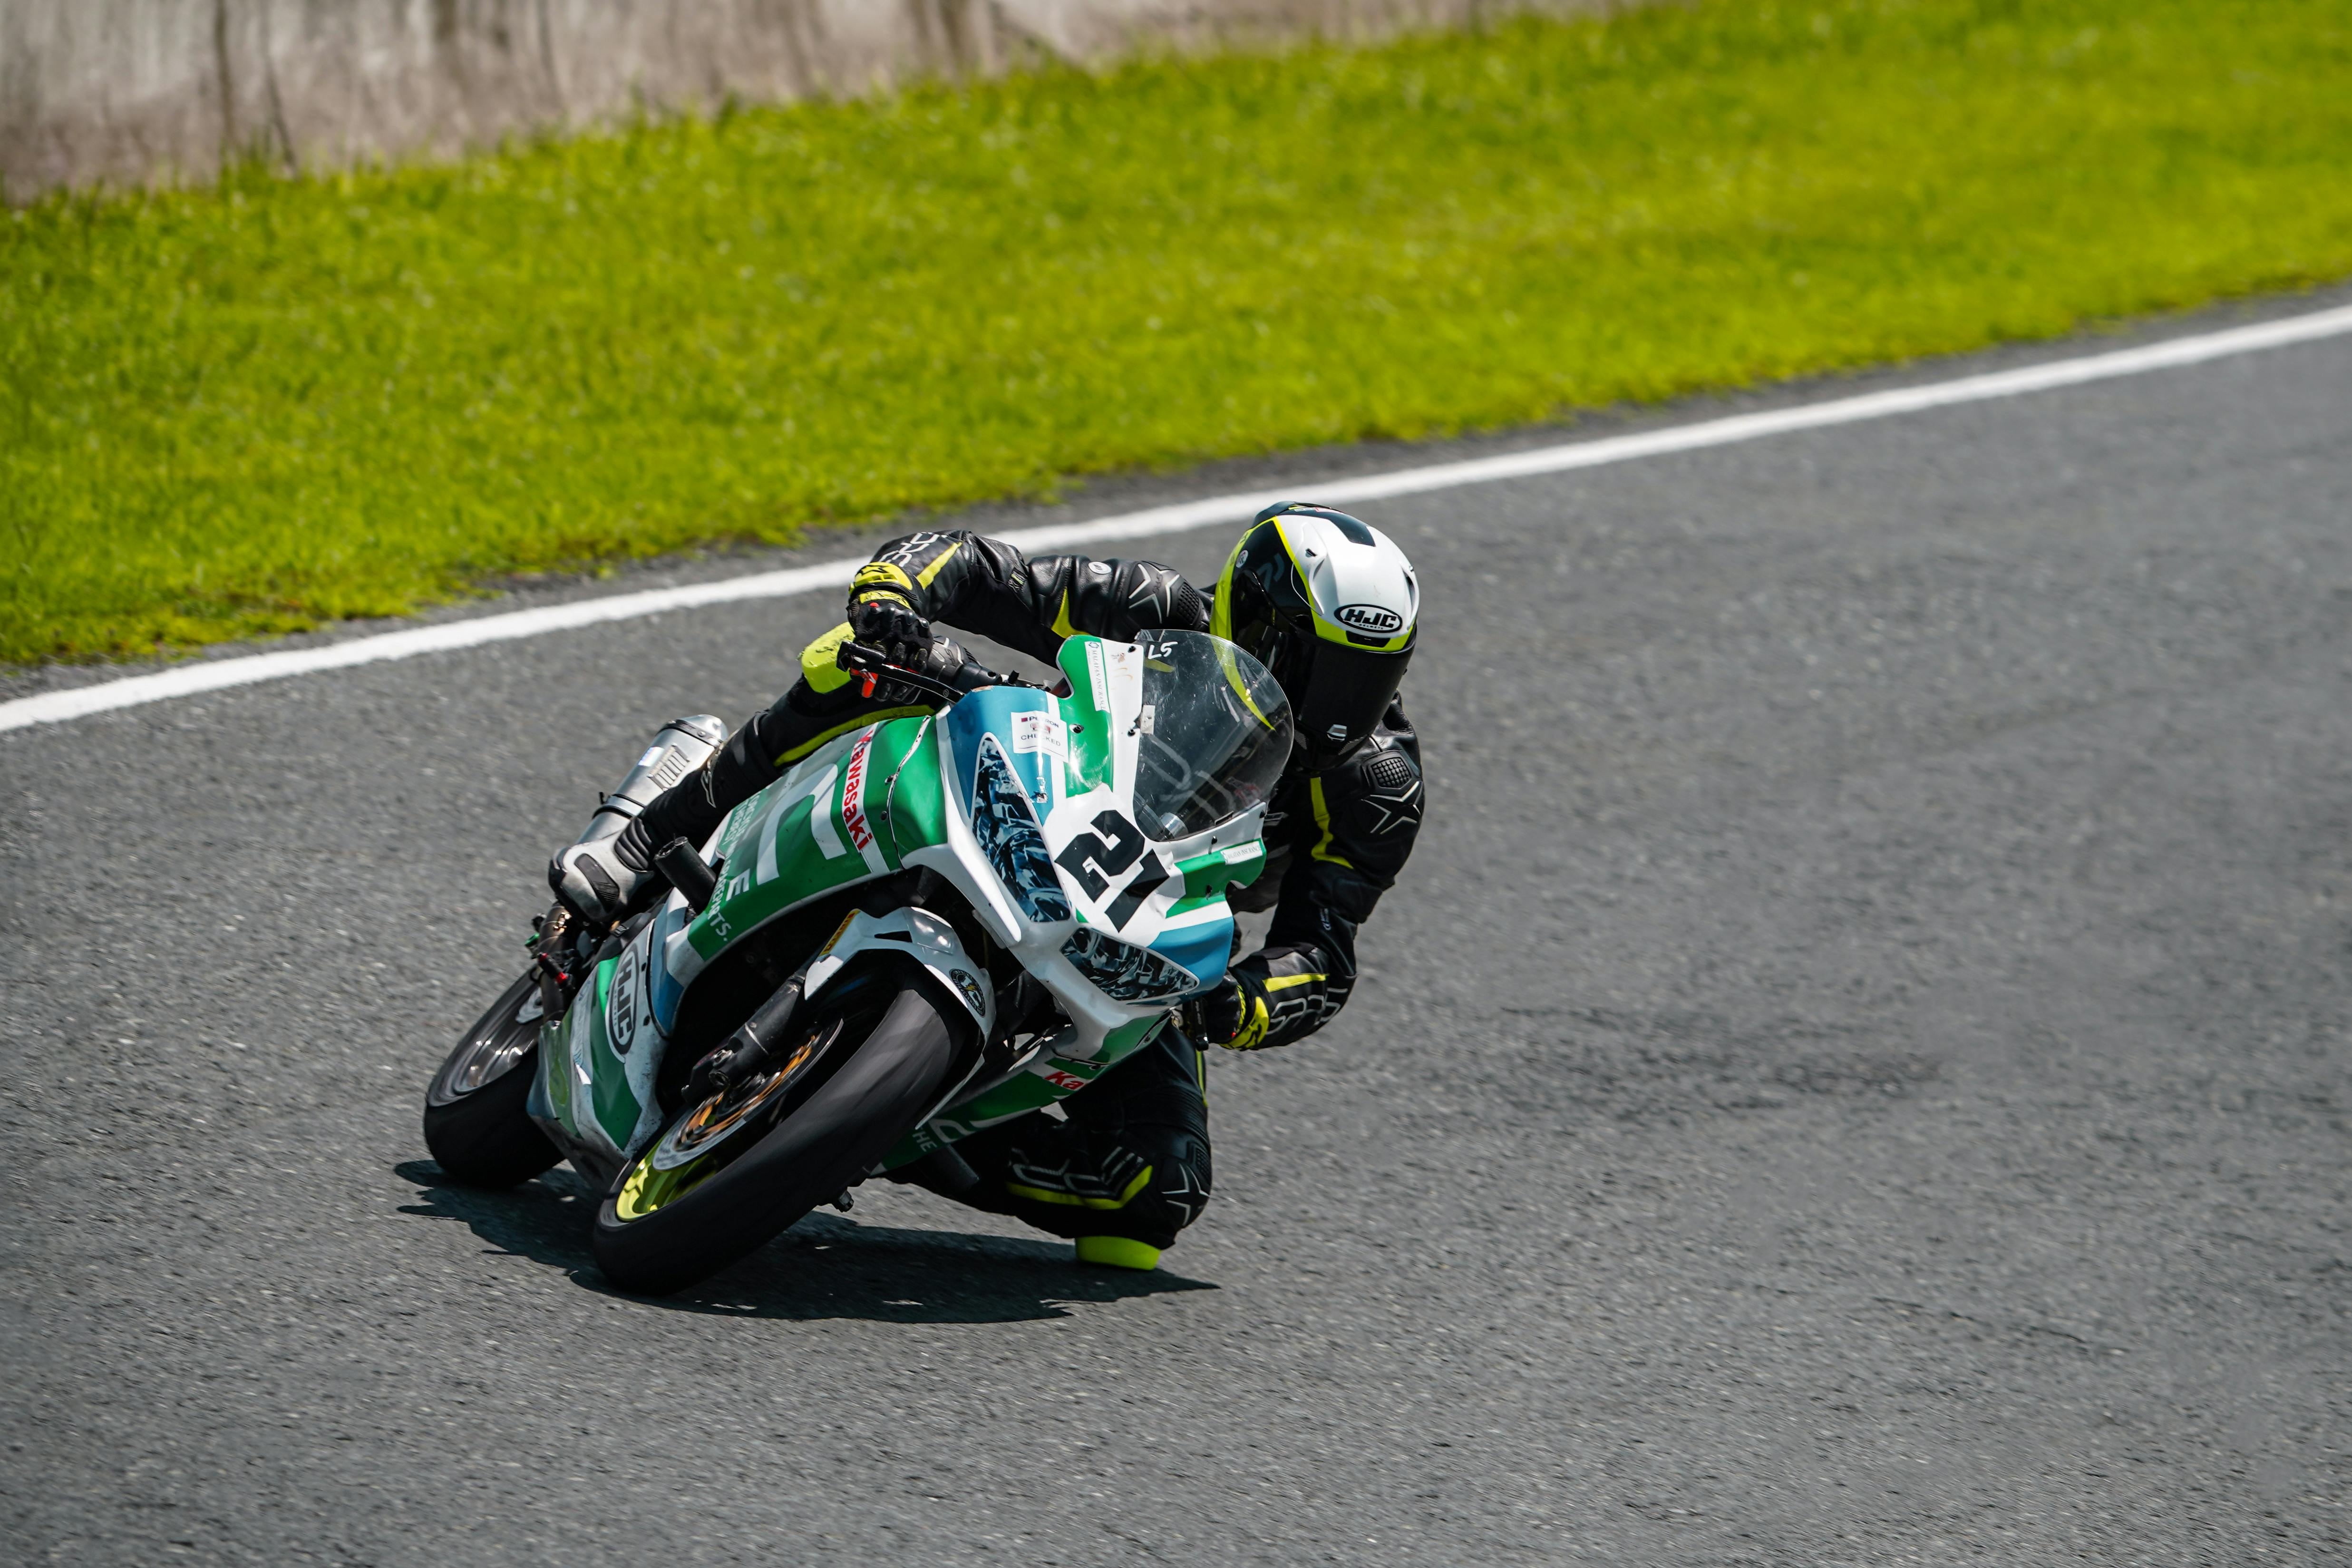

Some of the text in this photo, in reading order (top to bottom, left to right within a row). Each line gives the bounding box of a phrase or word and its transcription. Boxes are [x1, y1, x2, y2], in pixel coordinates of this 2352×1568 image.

[1343, 609, 1398, 628] HJC
[1020, 734, 1060, 746] CHEKED
[1029, 716, 1059, 728] PRON
[843, 730, 874, 850] Kawasaki
[1054, 809, 1170, 933] 21
[618, 956, 634, 1040] HJC
